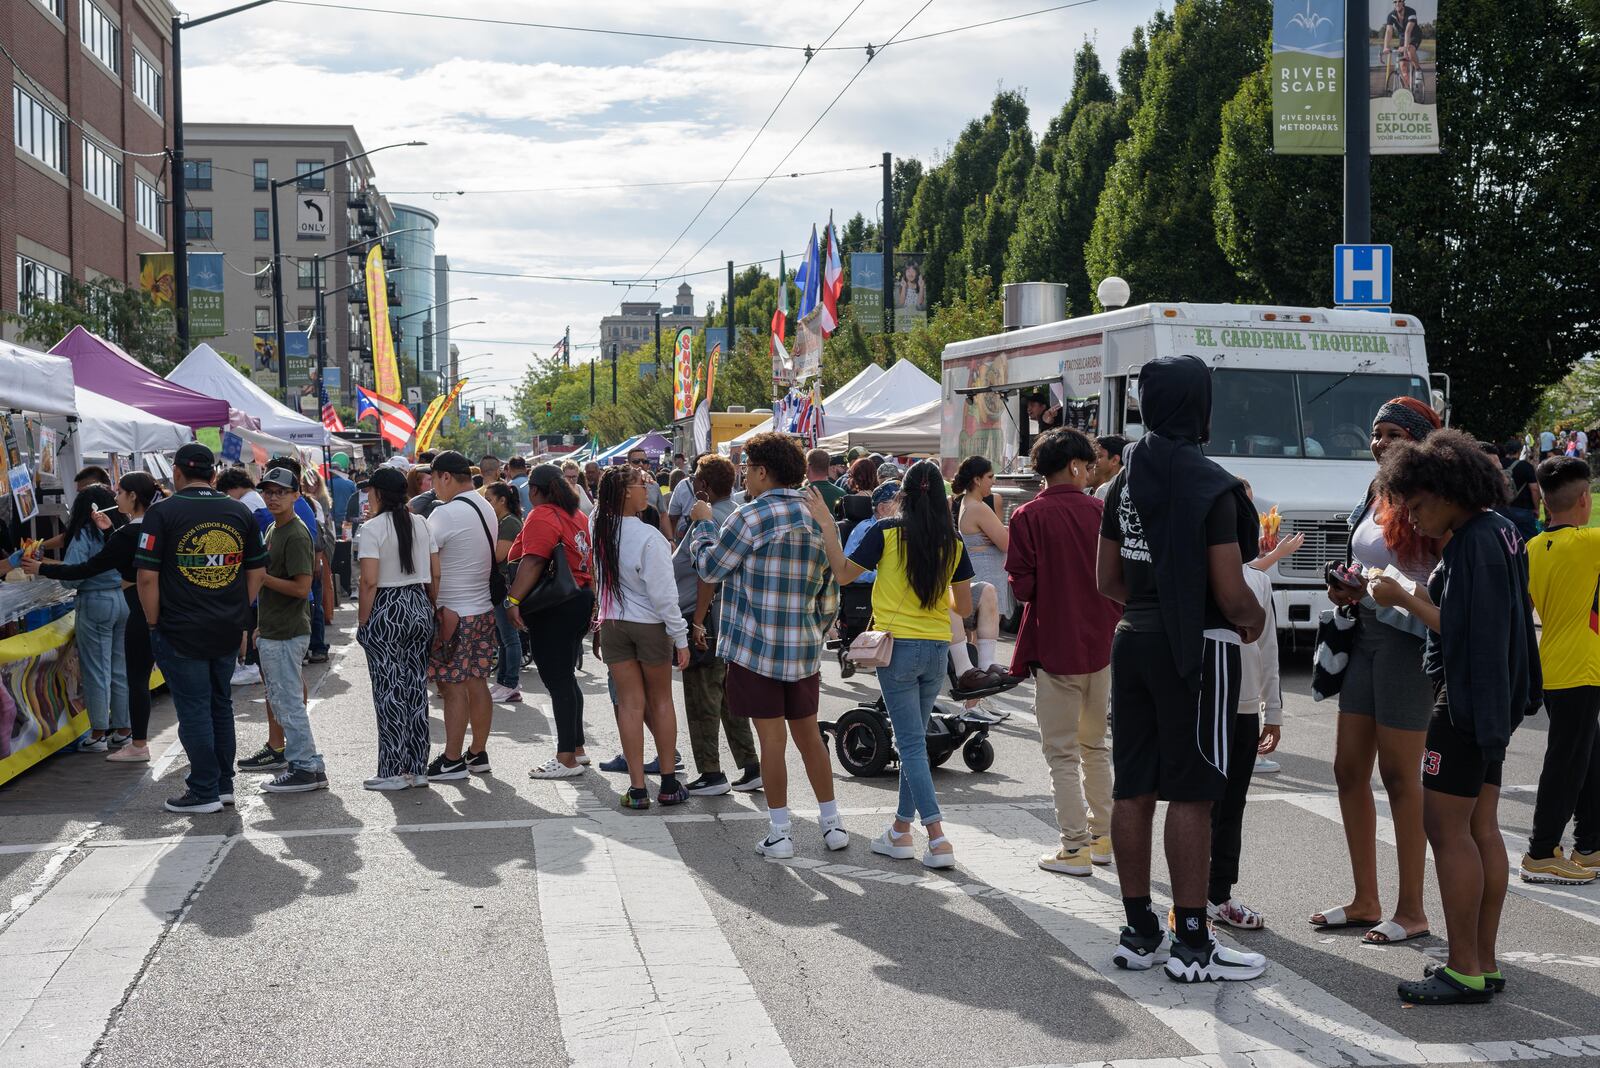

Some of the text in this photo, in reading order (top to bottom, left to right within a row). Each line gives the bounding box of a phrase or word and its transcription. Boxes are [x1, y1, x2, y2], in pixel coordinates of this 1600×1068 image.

[1281, 67, 1336, 80] RIVER
[1281, 81, 1336, 93] SCAPE
[1281, 114, 1337, 122] FIVE RIVERS
[1377, 112, 1429, 122] GET OUT &
[1279, 123, 1339, 132] METROPARKS
[1376, 123, 1432, 133] EXPLORE
[301, 223, 326, 231] ONLY
[1343, 249, 1382, 300] H
[1194, 328, 1390, 353] EL CARDENAL TAQUERIA
[194, 522, 221, 531] UNIDOS
[177, 551, 244, 567] MEXICO
